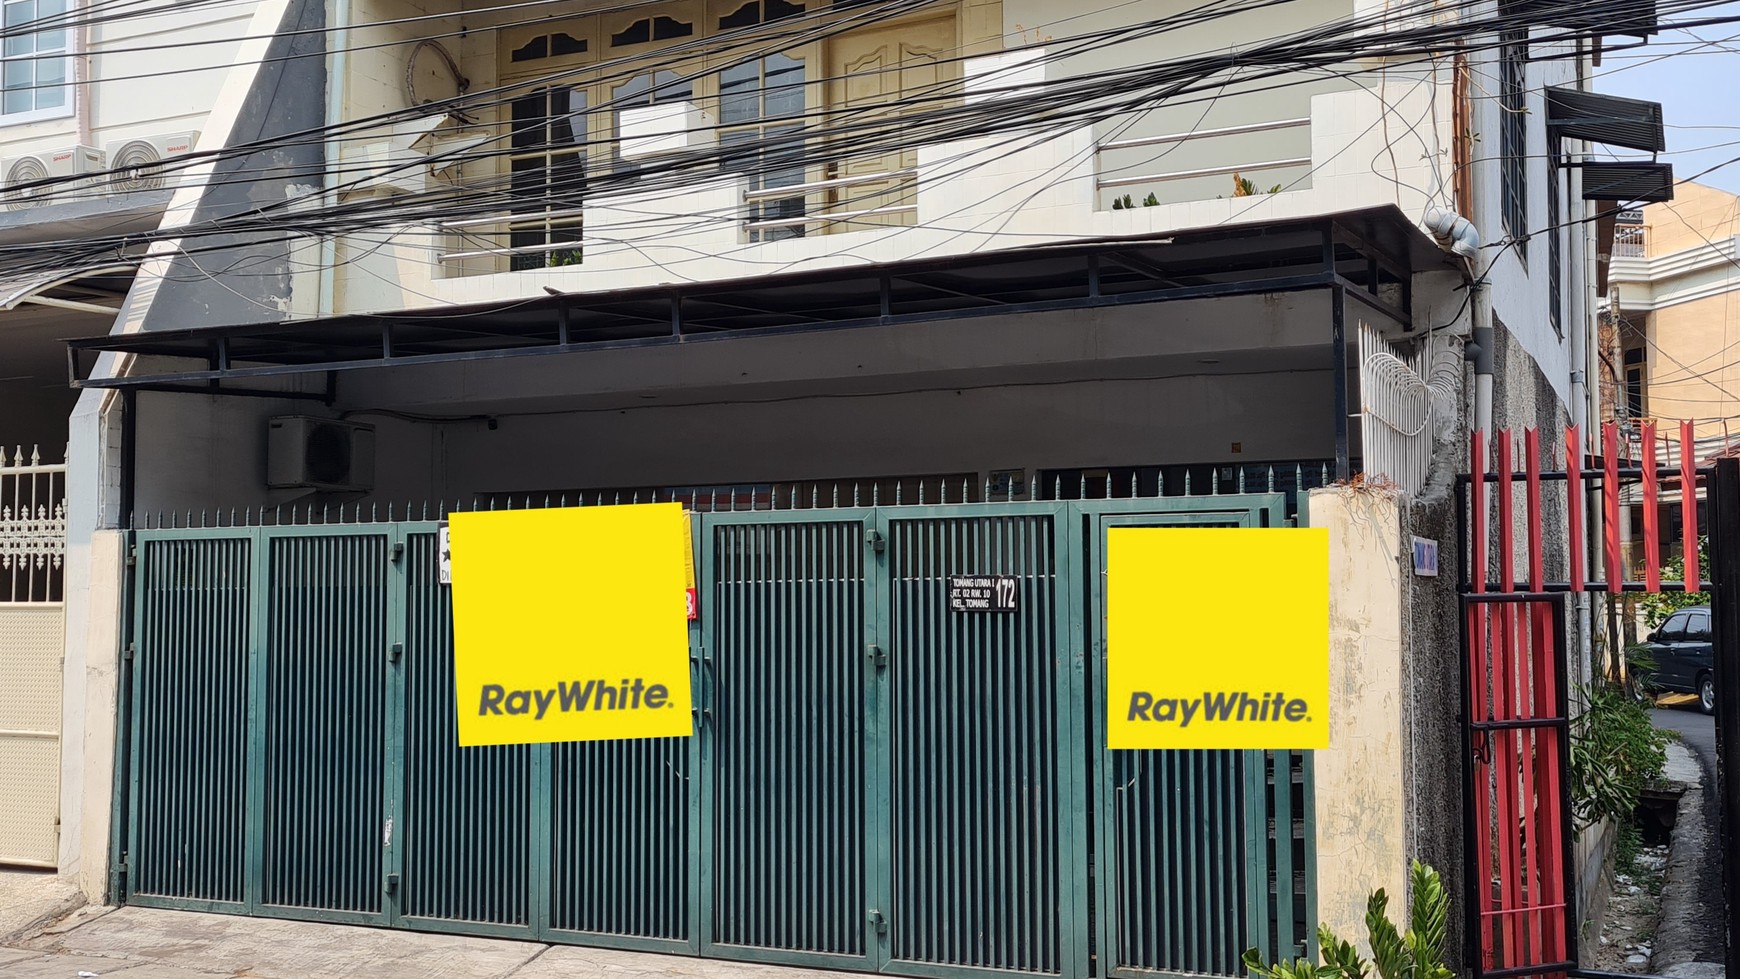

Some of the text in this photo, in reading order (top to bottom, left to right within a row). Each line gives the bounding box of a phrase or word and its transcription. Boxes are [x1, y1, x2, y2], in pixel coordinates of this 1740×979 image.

[953, 579, 974, 587] TOMANG
[975, 579, 992, 587] UTARA
[963, 589, 970, 597] 02
[971, 590, 982, 598] RW.
[983, 590, 990, 598] 10
[996, 578, 1015, 608] 172
[953, 599, 989, 608] KEL. TOMANG
